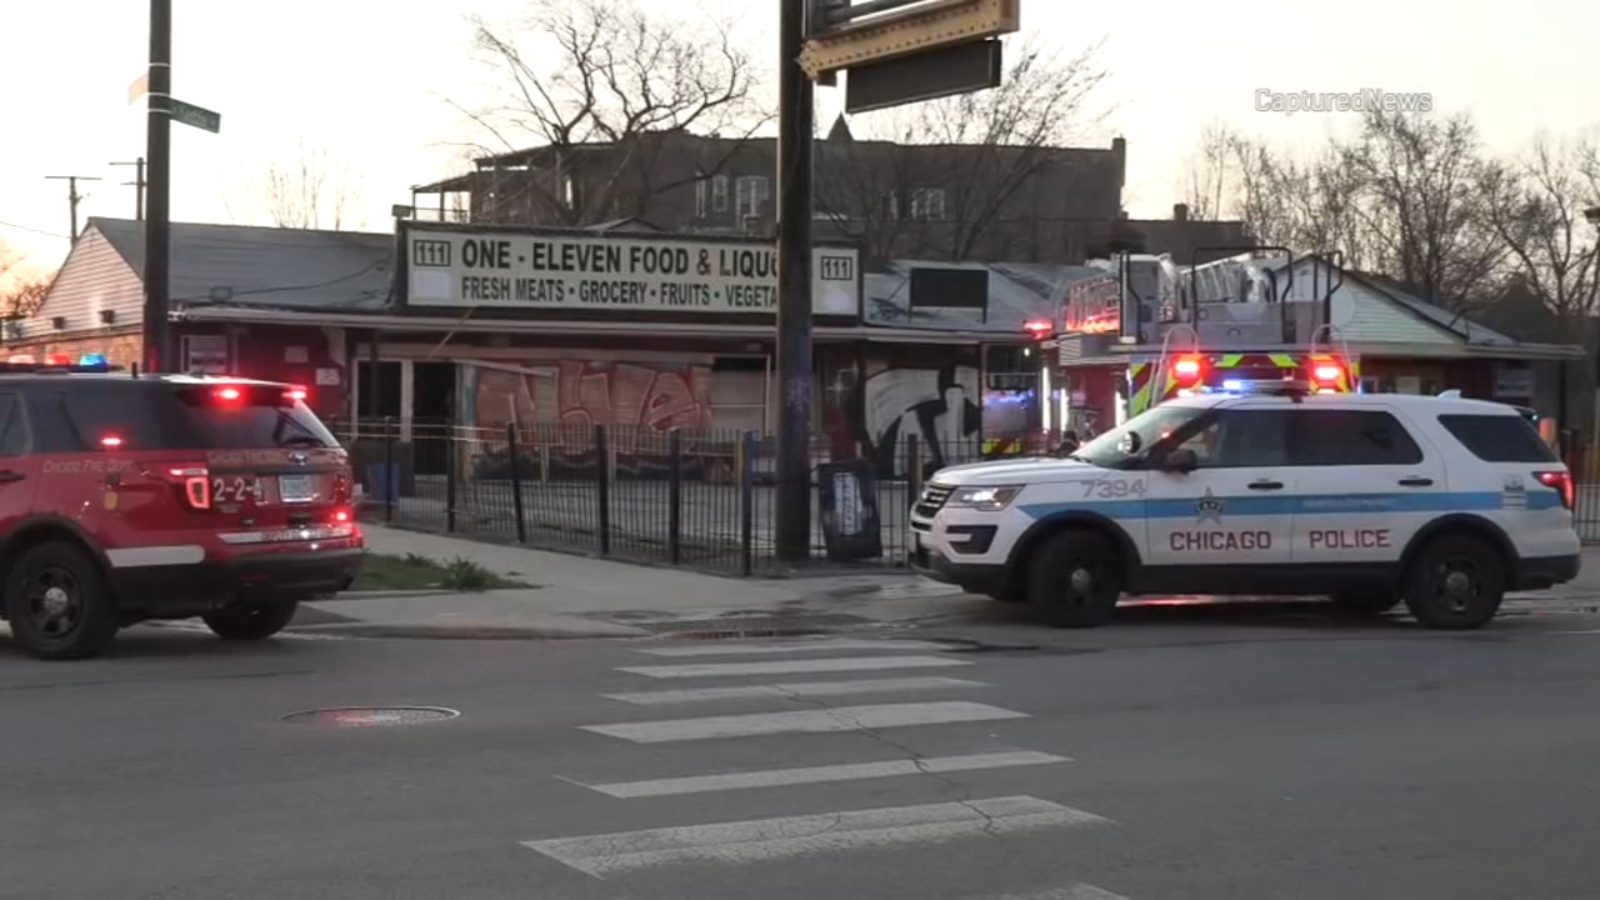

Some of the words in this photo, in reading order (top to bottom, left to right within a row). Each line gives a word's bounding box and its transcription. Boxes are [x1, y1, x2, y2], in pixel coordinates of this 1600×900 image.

[416, 242, 448, 265] 111
[462, 239, 510, 269] ONE
[533, 242, 621, 273] ELEVEN
[630, 246, 689, 275] FOOD
[697, 248, 711, 275] &
[823, 258, 850, 278] 111
[462, 277, 510, 301] FRESH
[516, 278, 564, 302] MEATS
[580, 280, 647, 304] GROCERY
[660, 284, 710, 306] FRUITS
[213, 477, 263, 501] 2-2-4
[1080, 479, 1146, 498] 7394
[1170, 530, 1272, 551] CHICAGO
[1309, 529, 1391, 549] POLICE
